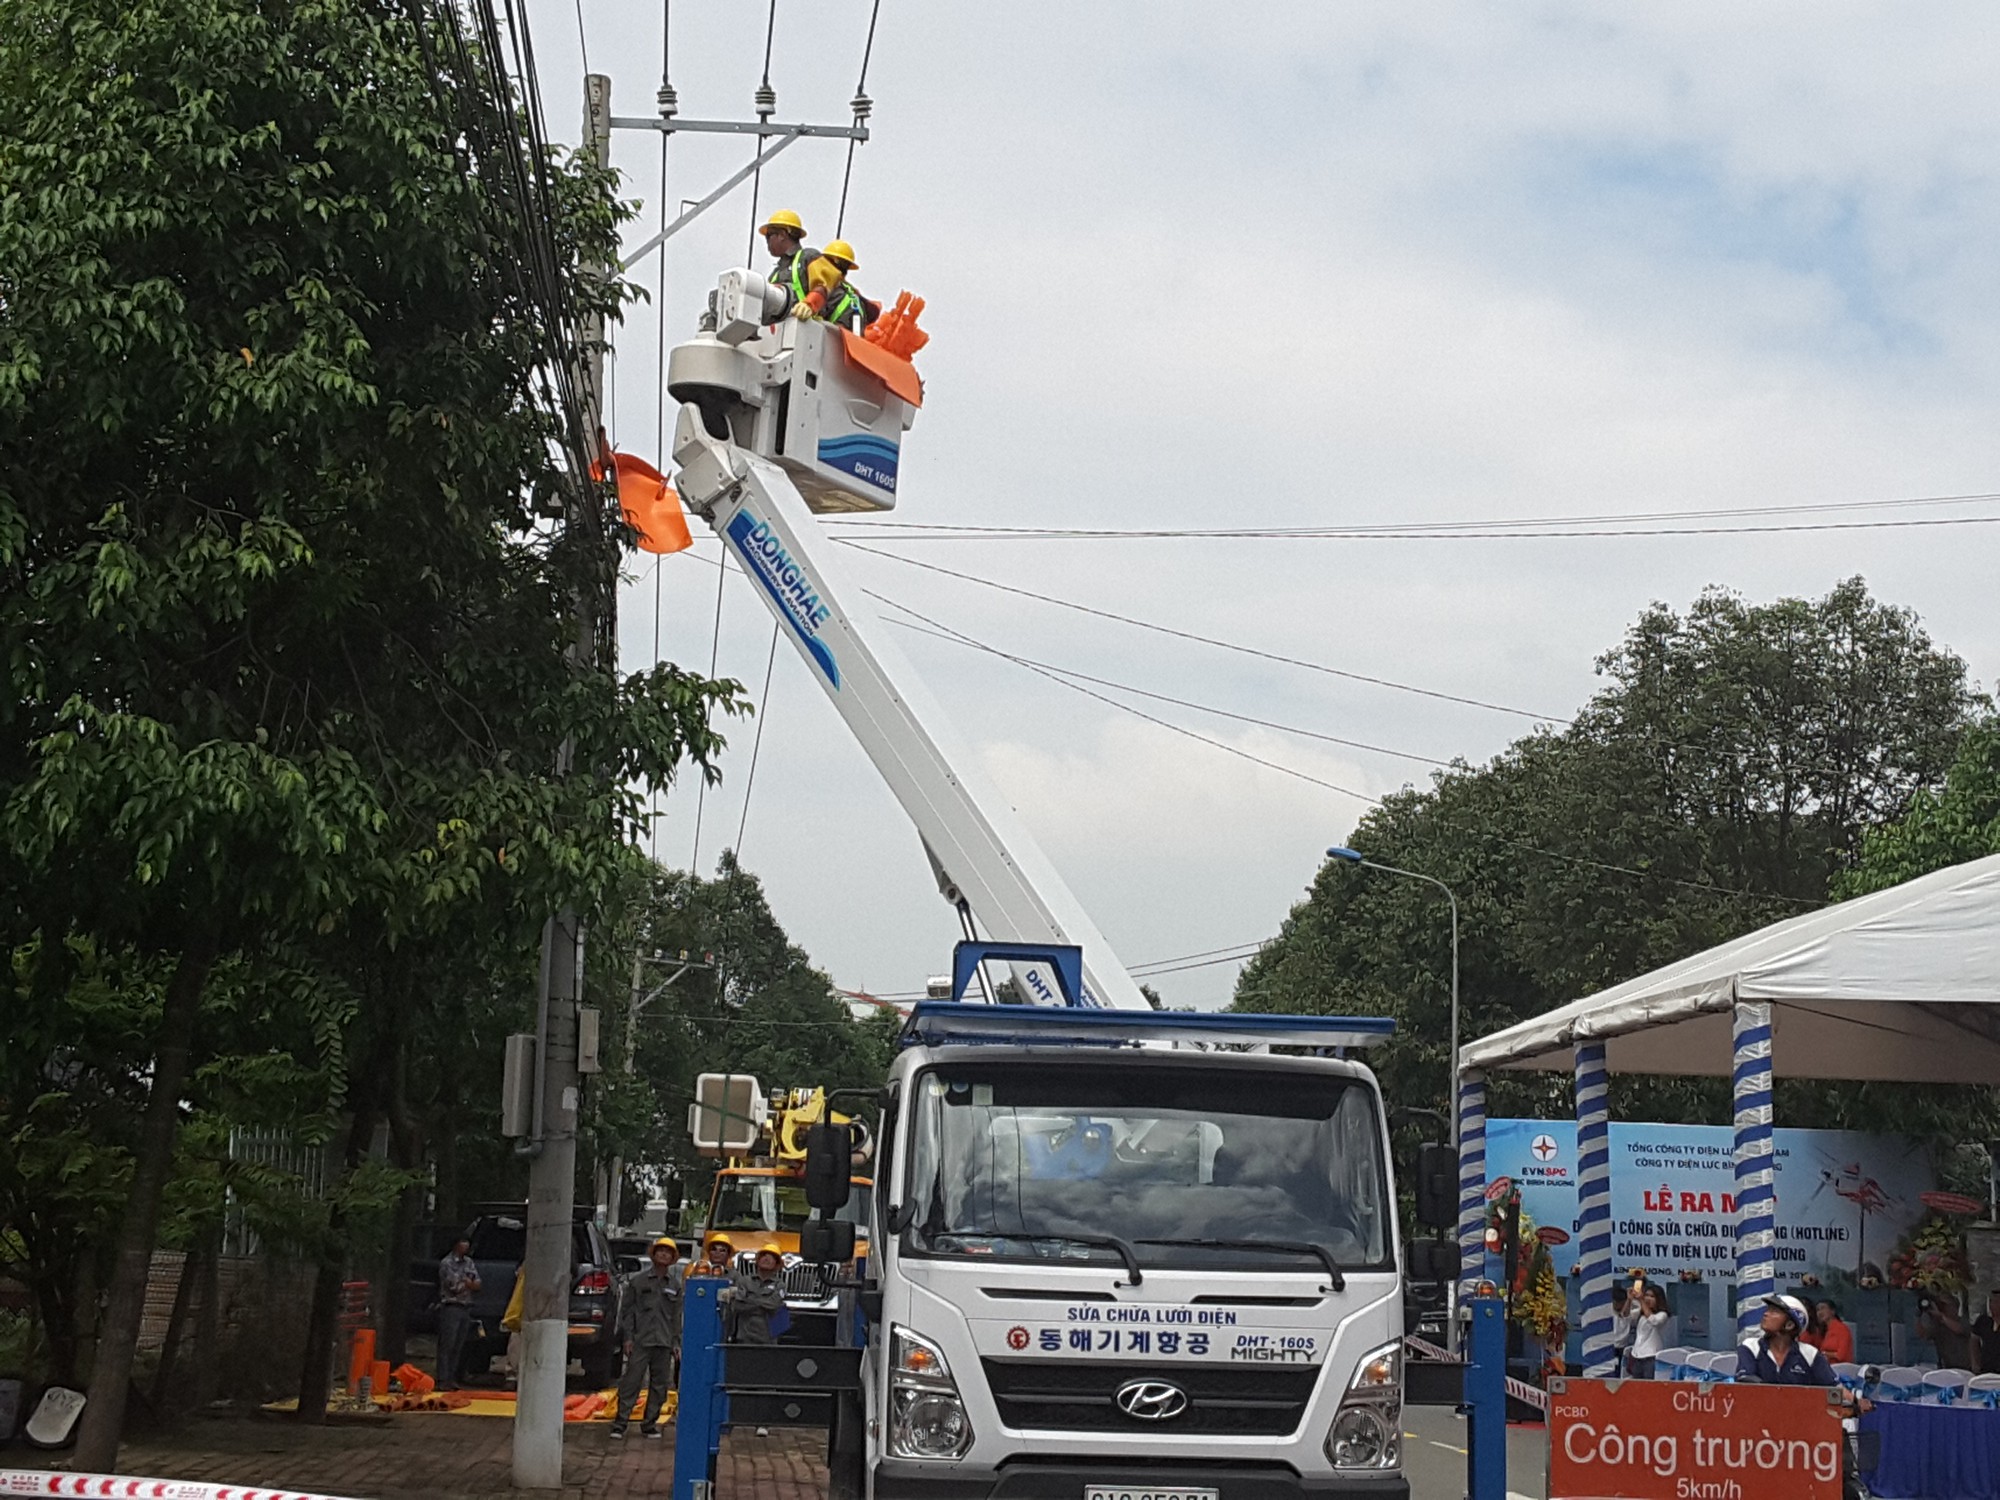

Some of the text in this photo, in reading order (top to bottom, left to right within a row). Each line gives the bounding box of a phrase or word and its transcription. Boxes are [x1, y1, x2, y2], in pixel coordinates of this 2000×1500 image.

[854, 461, 896, 489] DHT 160S
[750, 521, 831, 629] DONGHAE
[744, 538, 782, 588] MACHINERY
[785, 597, 814, 636] AVIATION
[1025, 969, 1053, 1001] DHT
[1655, 1143, 1682, 1154] CÔNG
[1683, 1145, 1695, 1155] TY
[1664, 1158, 1675, 1169] TY
[1680, 1192, 1714, 1213] RA
[1619, 1220, 1653, 1235] CÔNG
[1657, 1218, 1682, 1236] SỬA
[1684, 1221, 1718, 1238] CHỮA
[1790, 1225, 1850, 1241] (HOTLINE)
[1617, 1240, 1651, 1257] CÔNG
[1655, 1244, 1669, 1258] TY
[1672, 1242, 1701, 1262] ĐIỆN
[1704, 1245, 1728, 1262] LỰC
[1067, 1303, 1237, 1330] SỬA CHỮA LƯỚI ĐIỆN
[1038, 1327, 1211, 1355] 동해기계항공
[1230, 1346, 1318, 1362] MIGHTY
[1554, 1405, 1590, 1419] PCBD
[1563, 1422, 1838, 1482] Công trường
[1675, 1477, 1743, 1500] 5km/h
